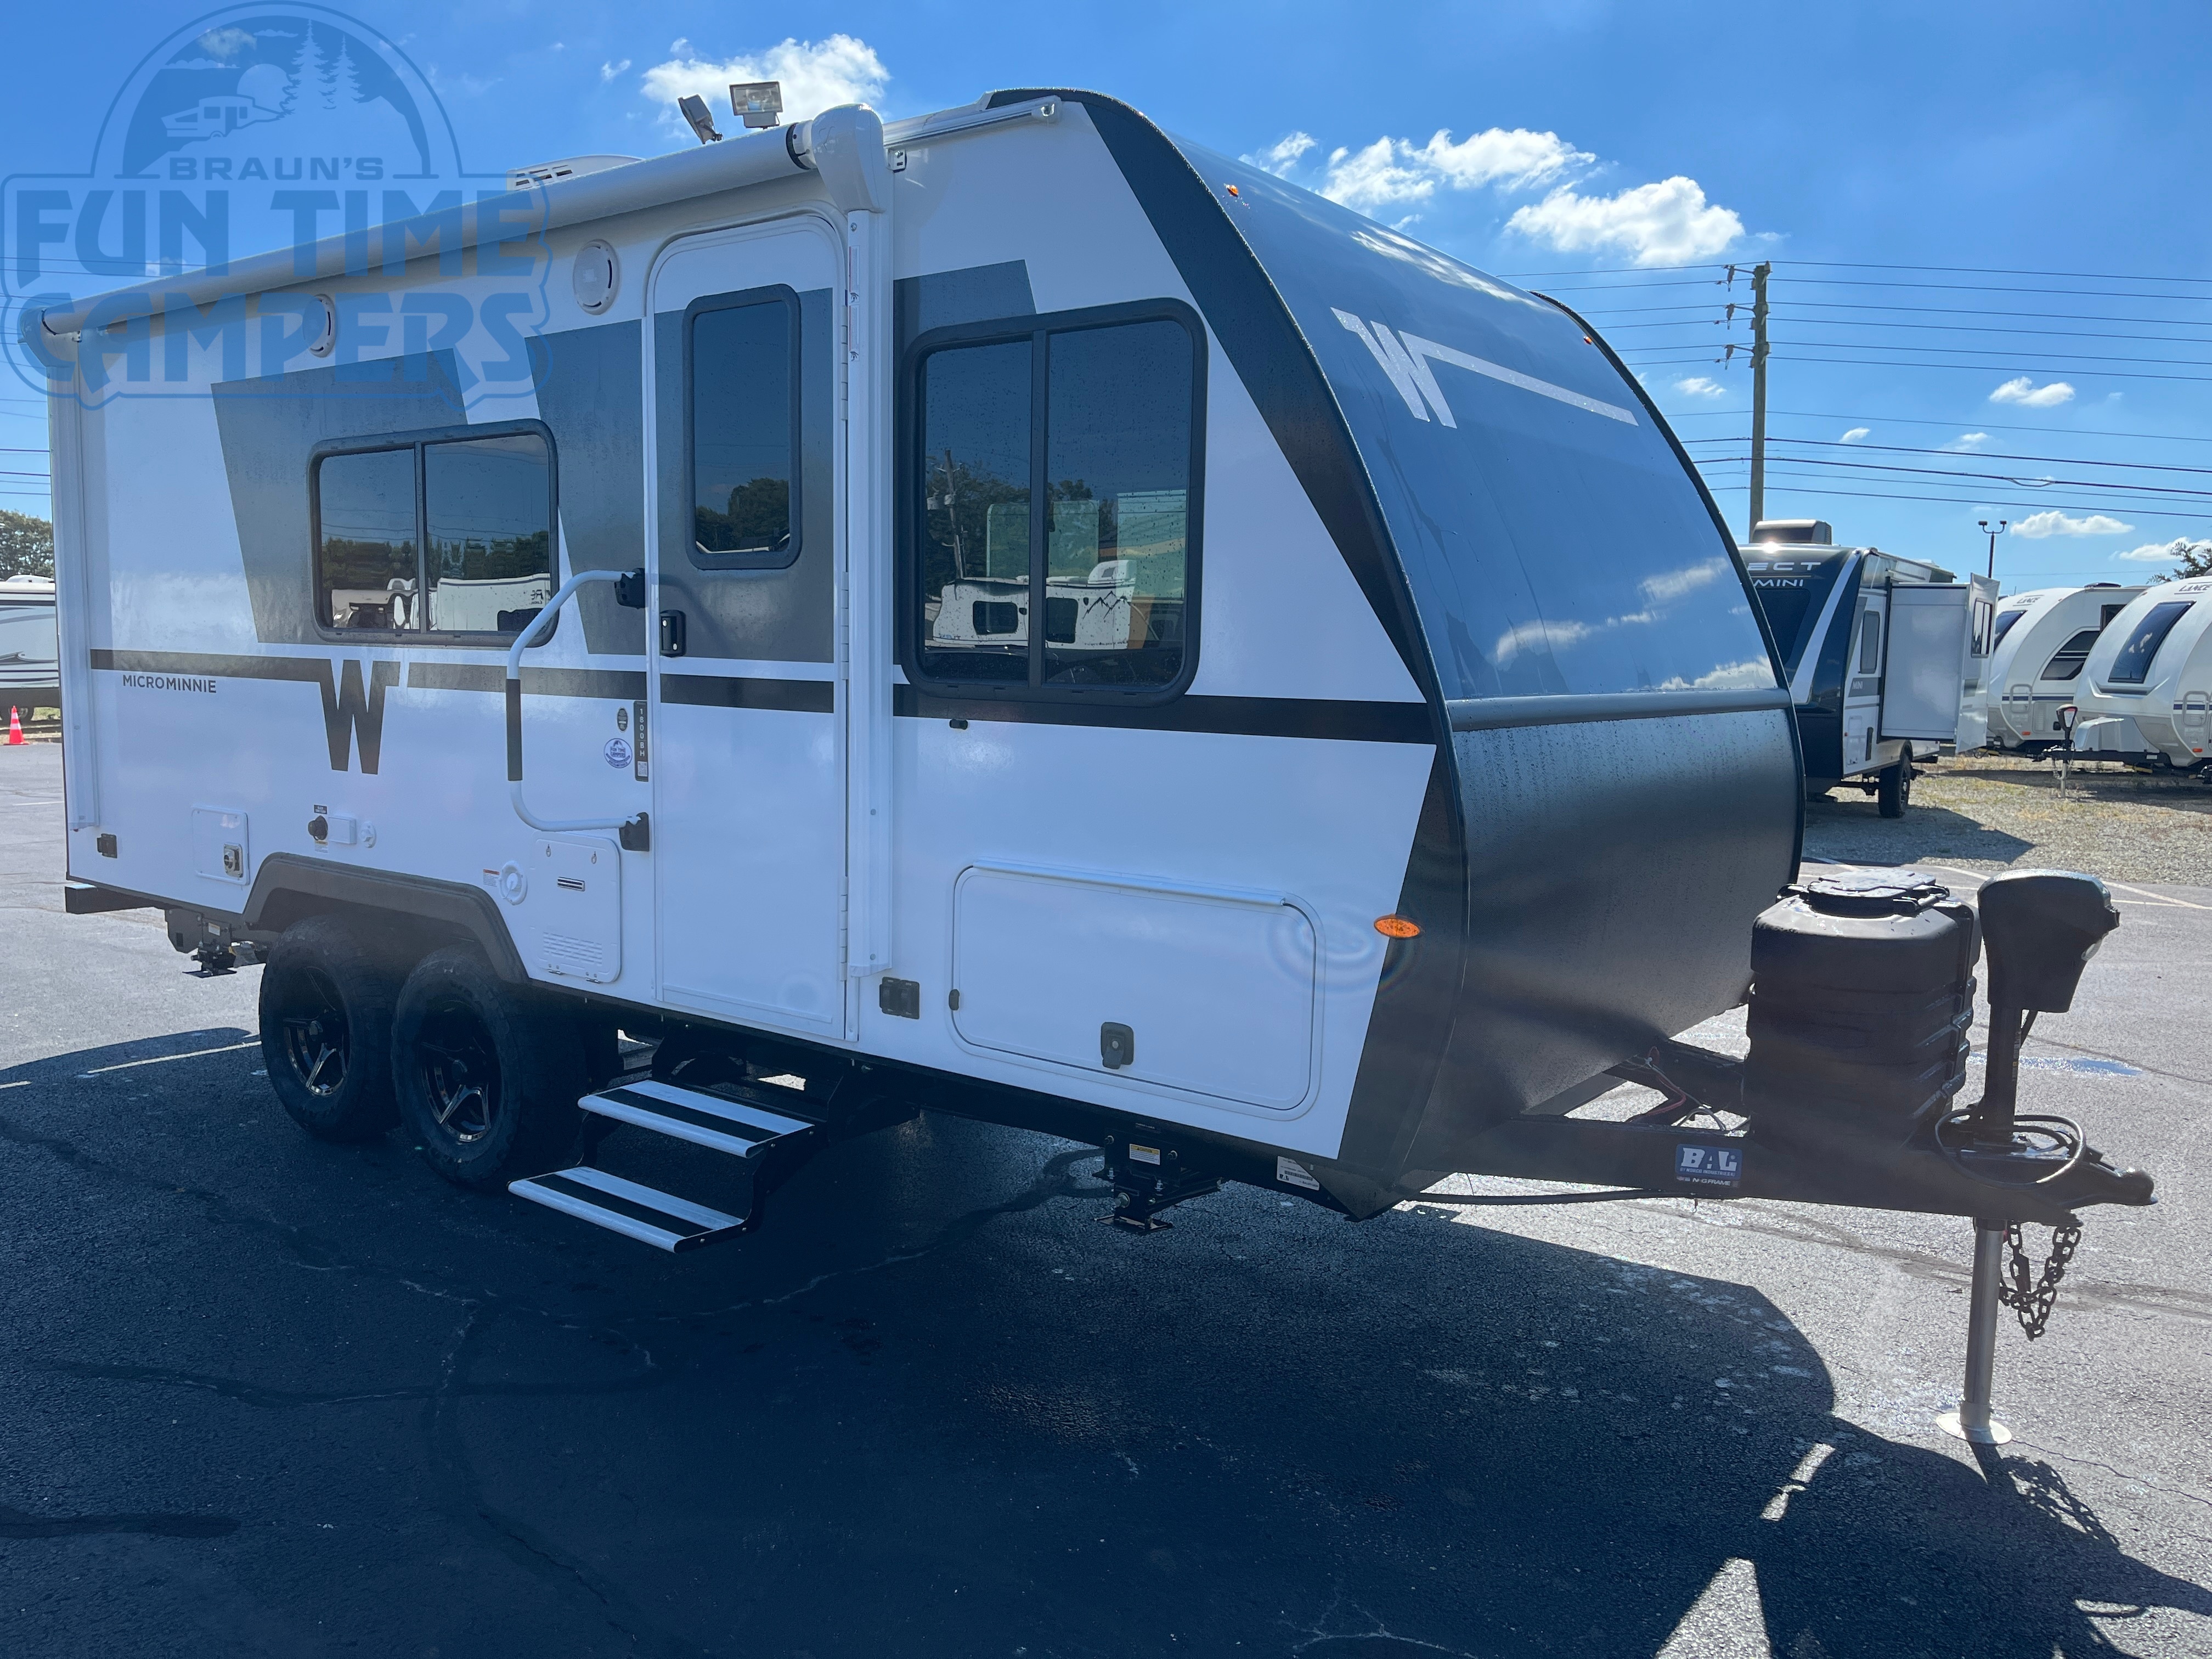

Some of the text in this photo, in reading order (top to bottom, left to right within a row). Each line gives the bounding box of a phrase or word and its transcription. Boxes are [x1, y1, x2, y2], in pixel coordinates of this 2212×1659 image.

[1754, 579, 1804, 587] MINI
[122, 674, 217, 693] MICROMINNIE
[1680, 1147, 1737, 1171] BAL
